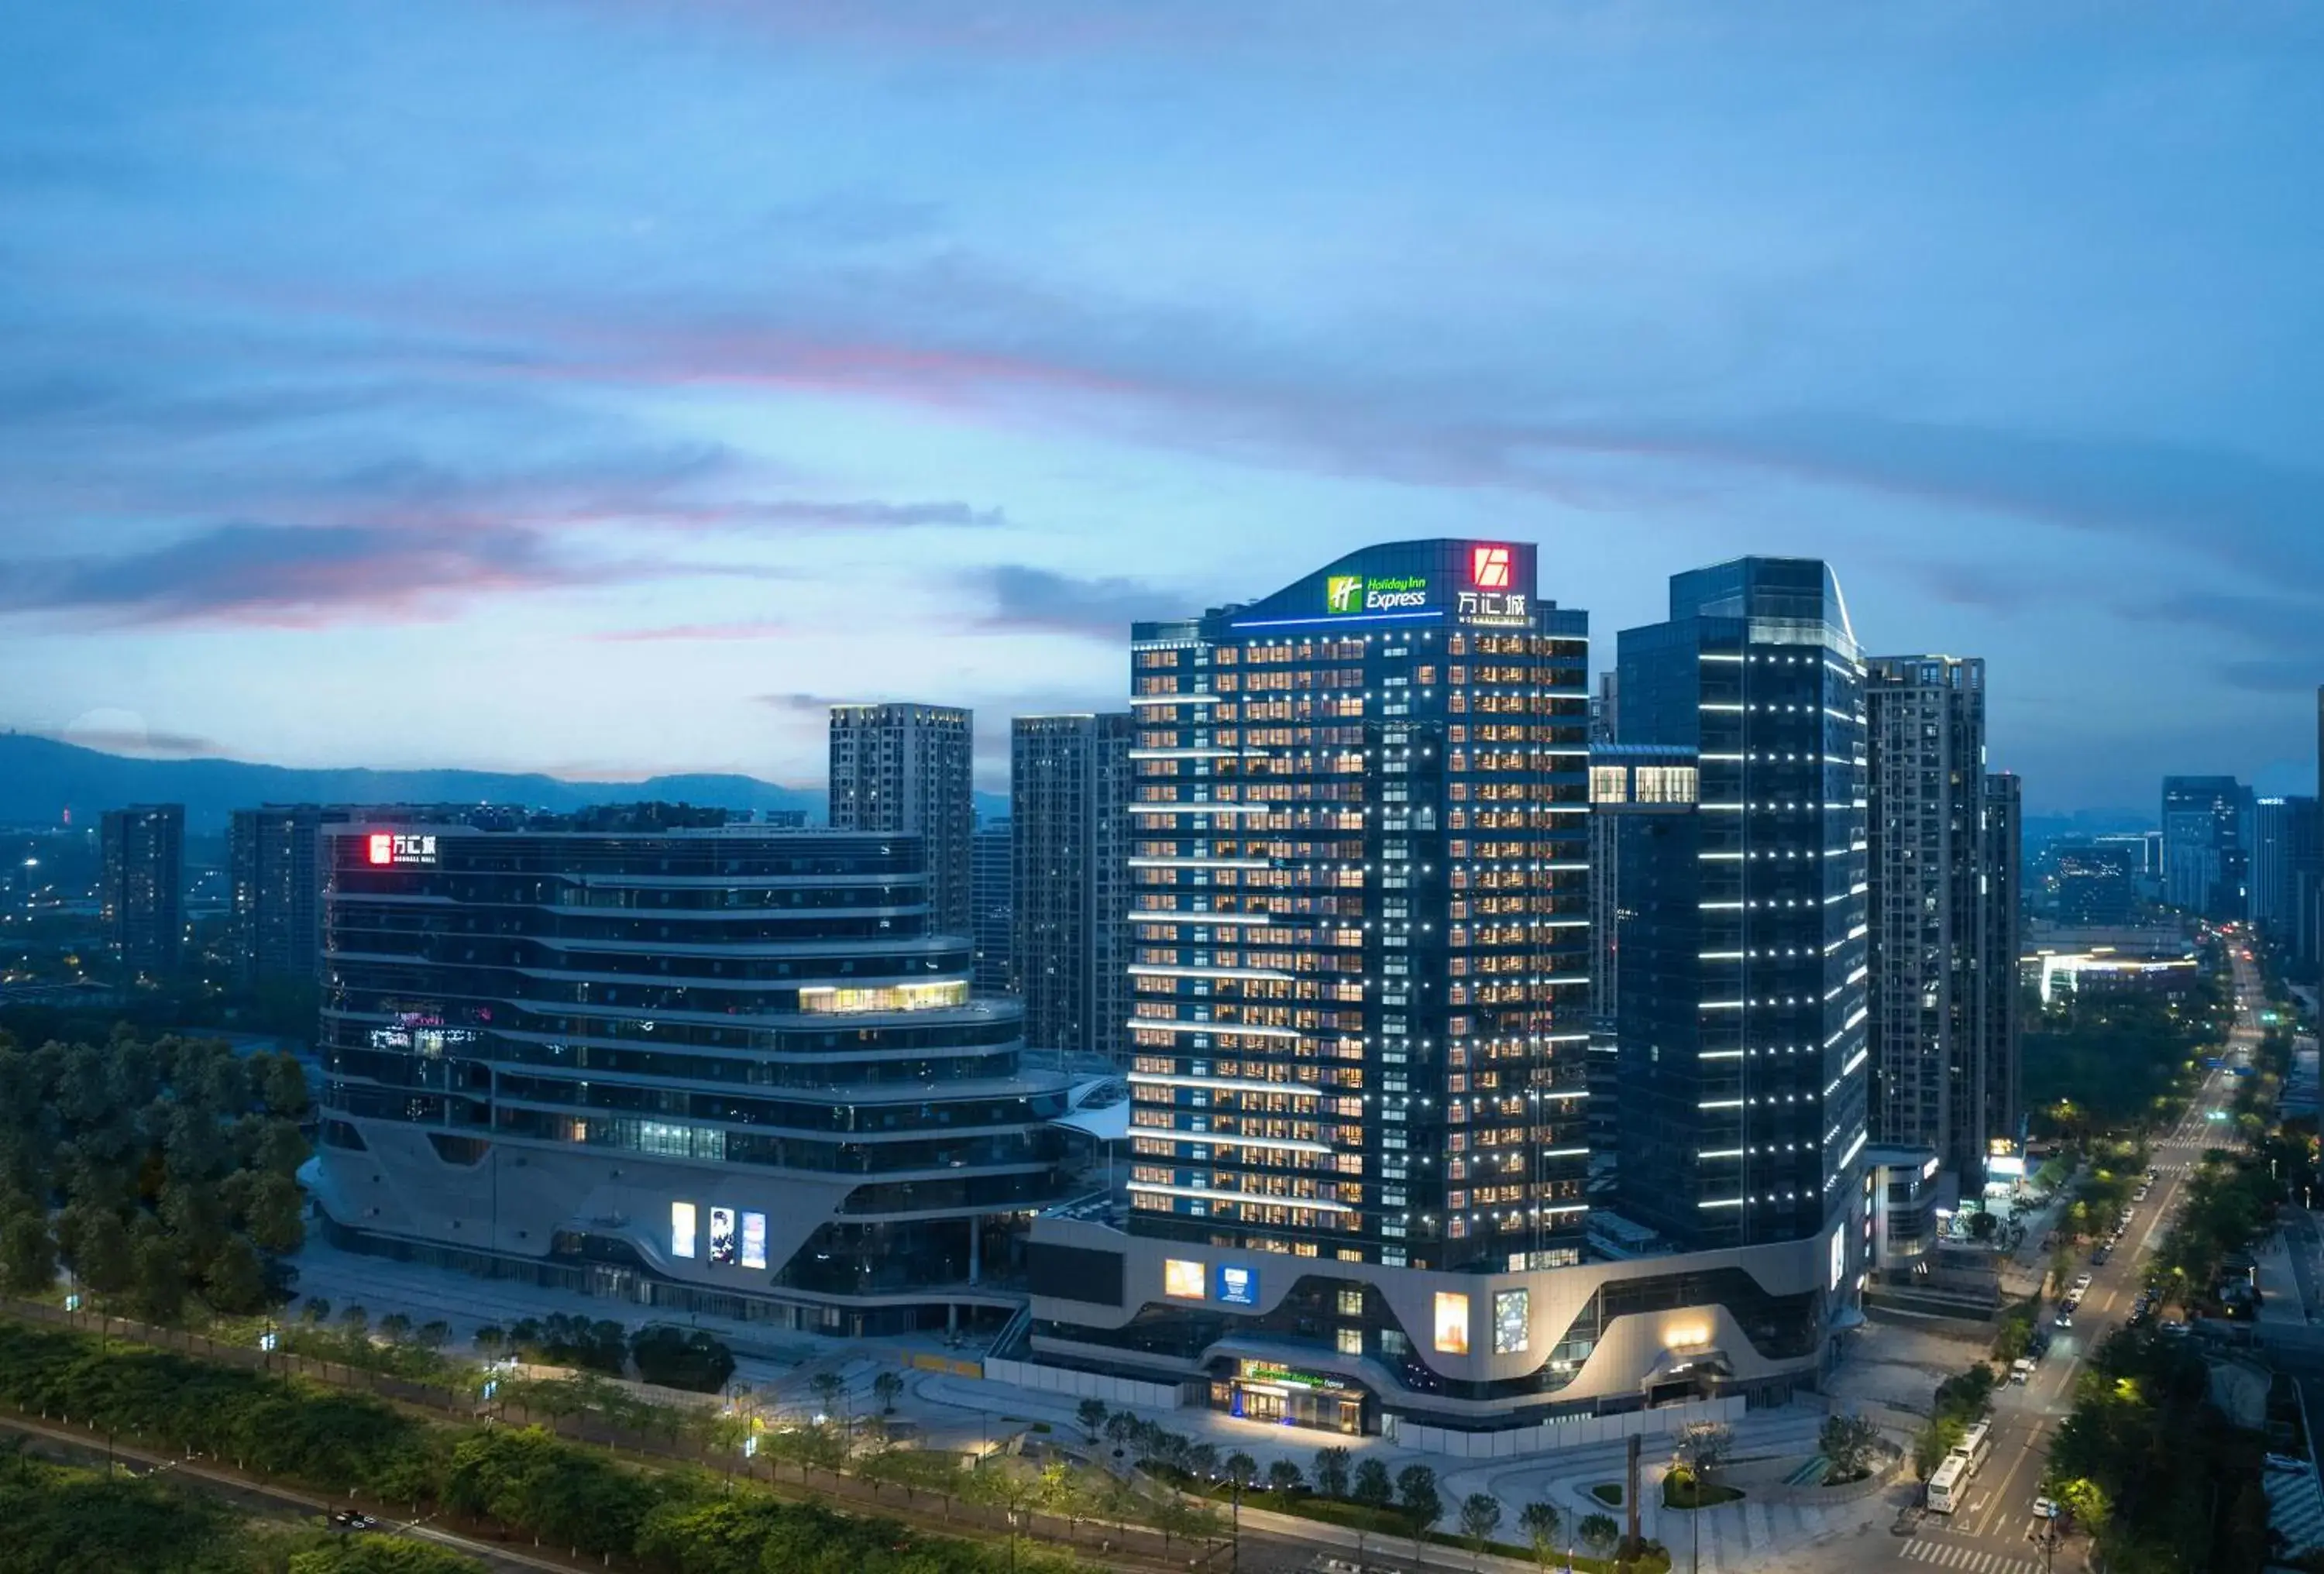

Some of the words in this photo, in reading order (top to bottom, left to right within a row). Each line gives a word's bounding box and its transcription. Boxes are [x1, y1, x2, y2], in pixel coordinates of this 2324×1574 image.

[1367, 576, 1408, 591] Holiday
[1408, 575, 1426, 588] Inn
[1367, 591, 1426, 611] Express
[1458, 591, 1525, 616] 万汇城
